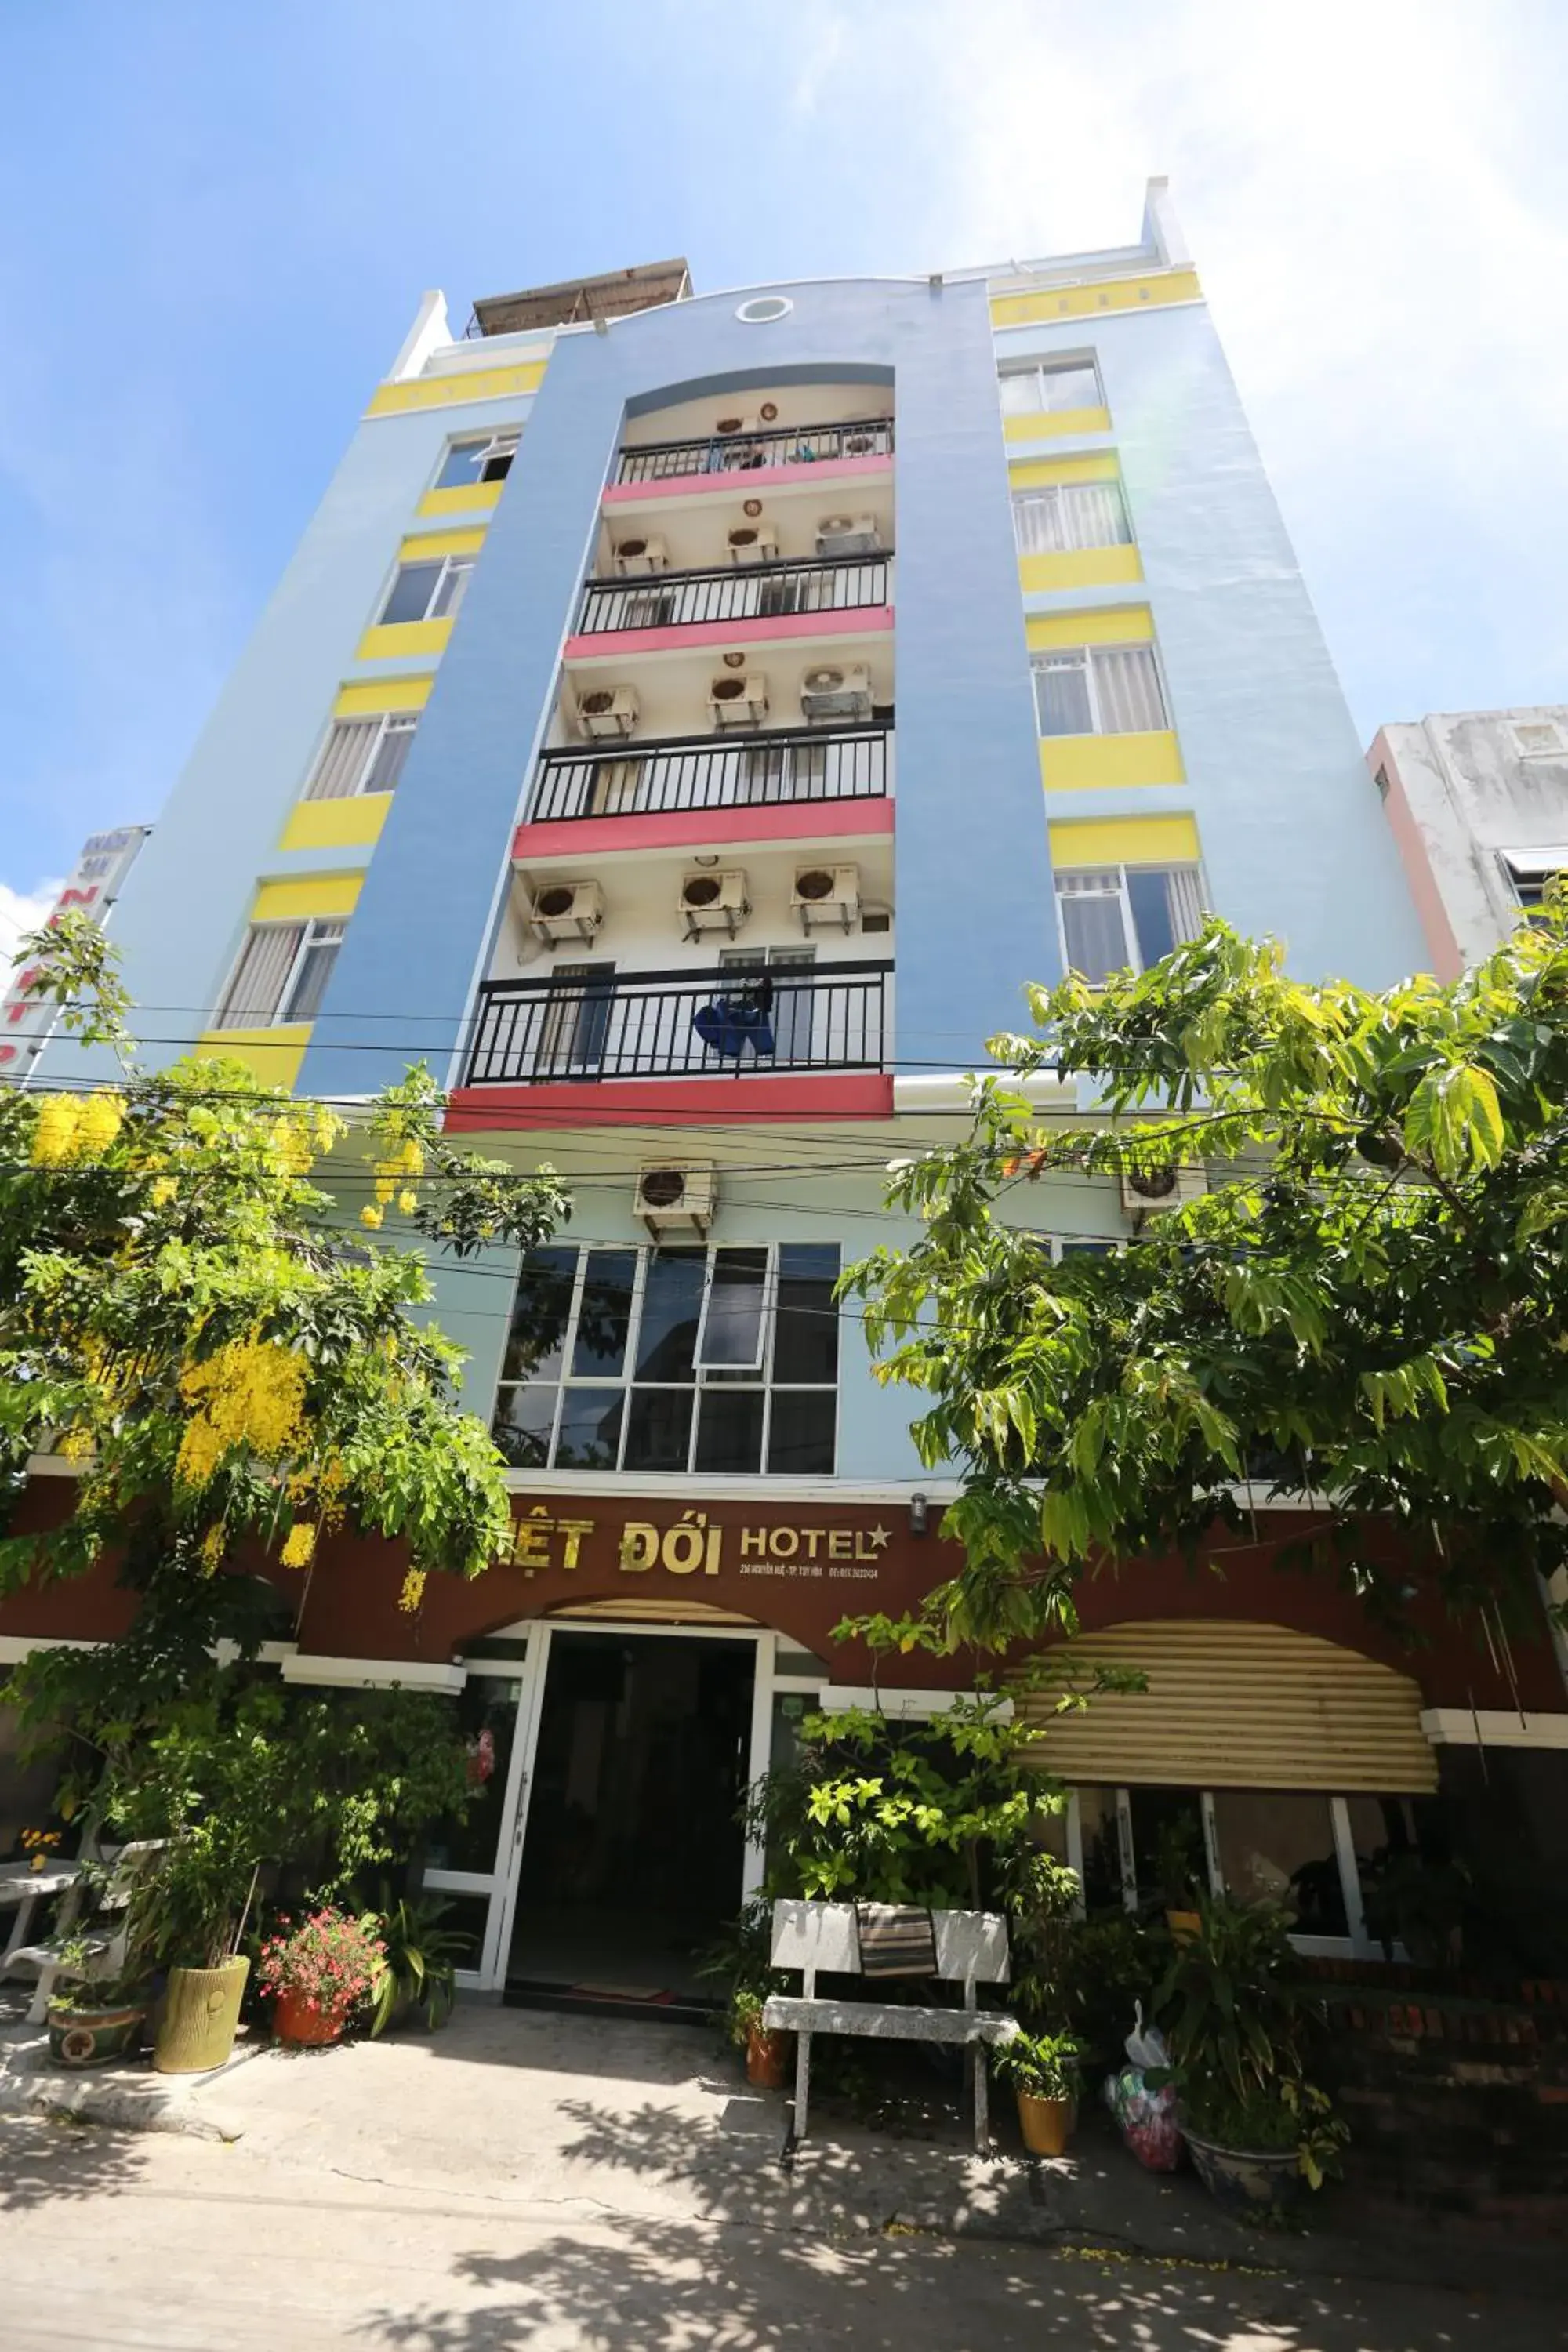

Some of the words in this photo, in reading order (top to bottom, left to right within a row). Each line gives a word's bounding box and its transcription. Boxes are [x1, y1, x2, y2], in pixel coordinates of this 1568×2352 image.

[491, 1506, 596, 1577] IỆT
[619, 1510, 723, 1574] ĐỚI
[740, 1527, 879, 1560] HOTEL
